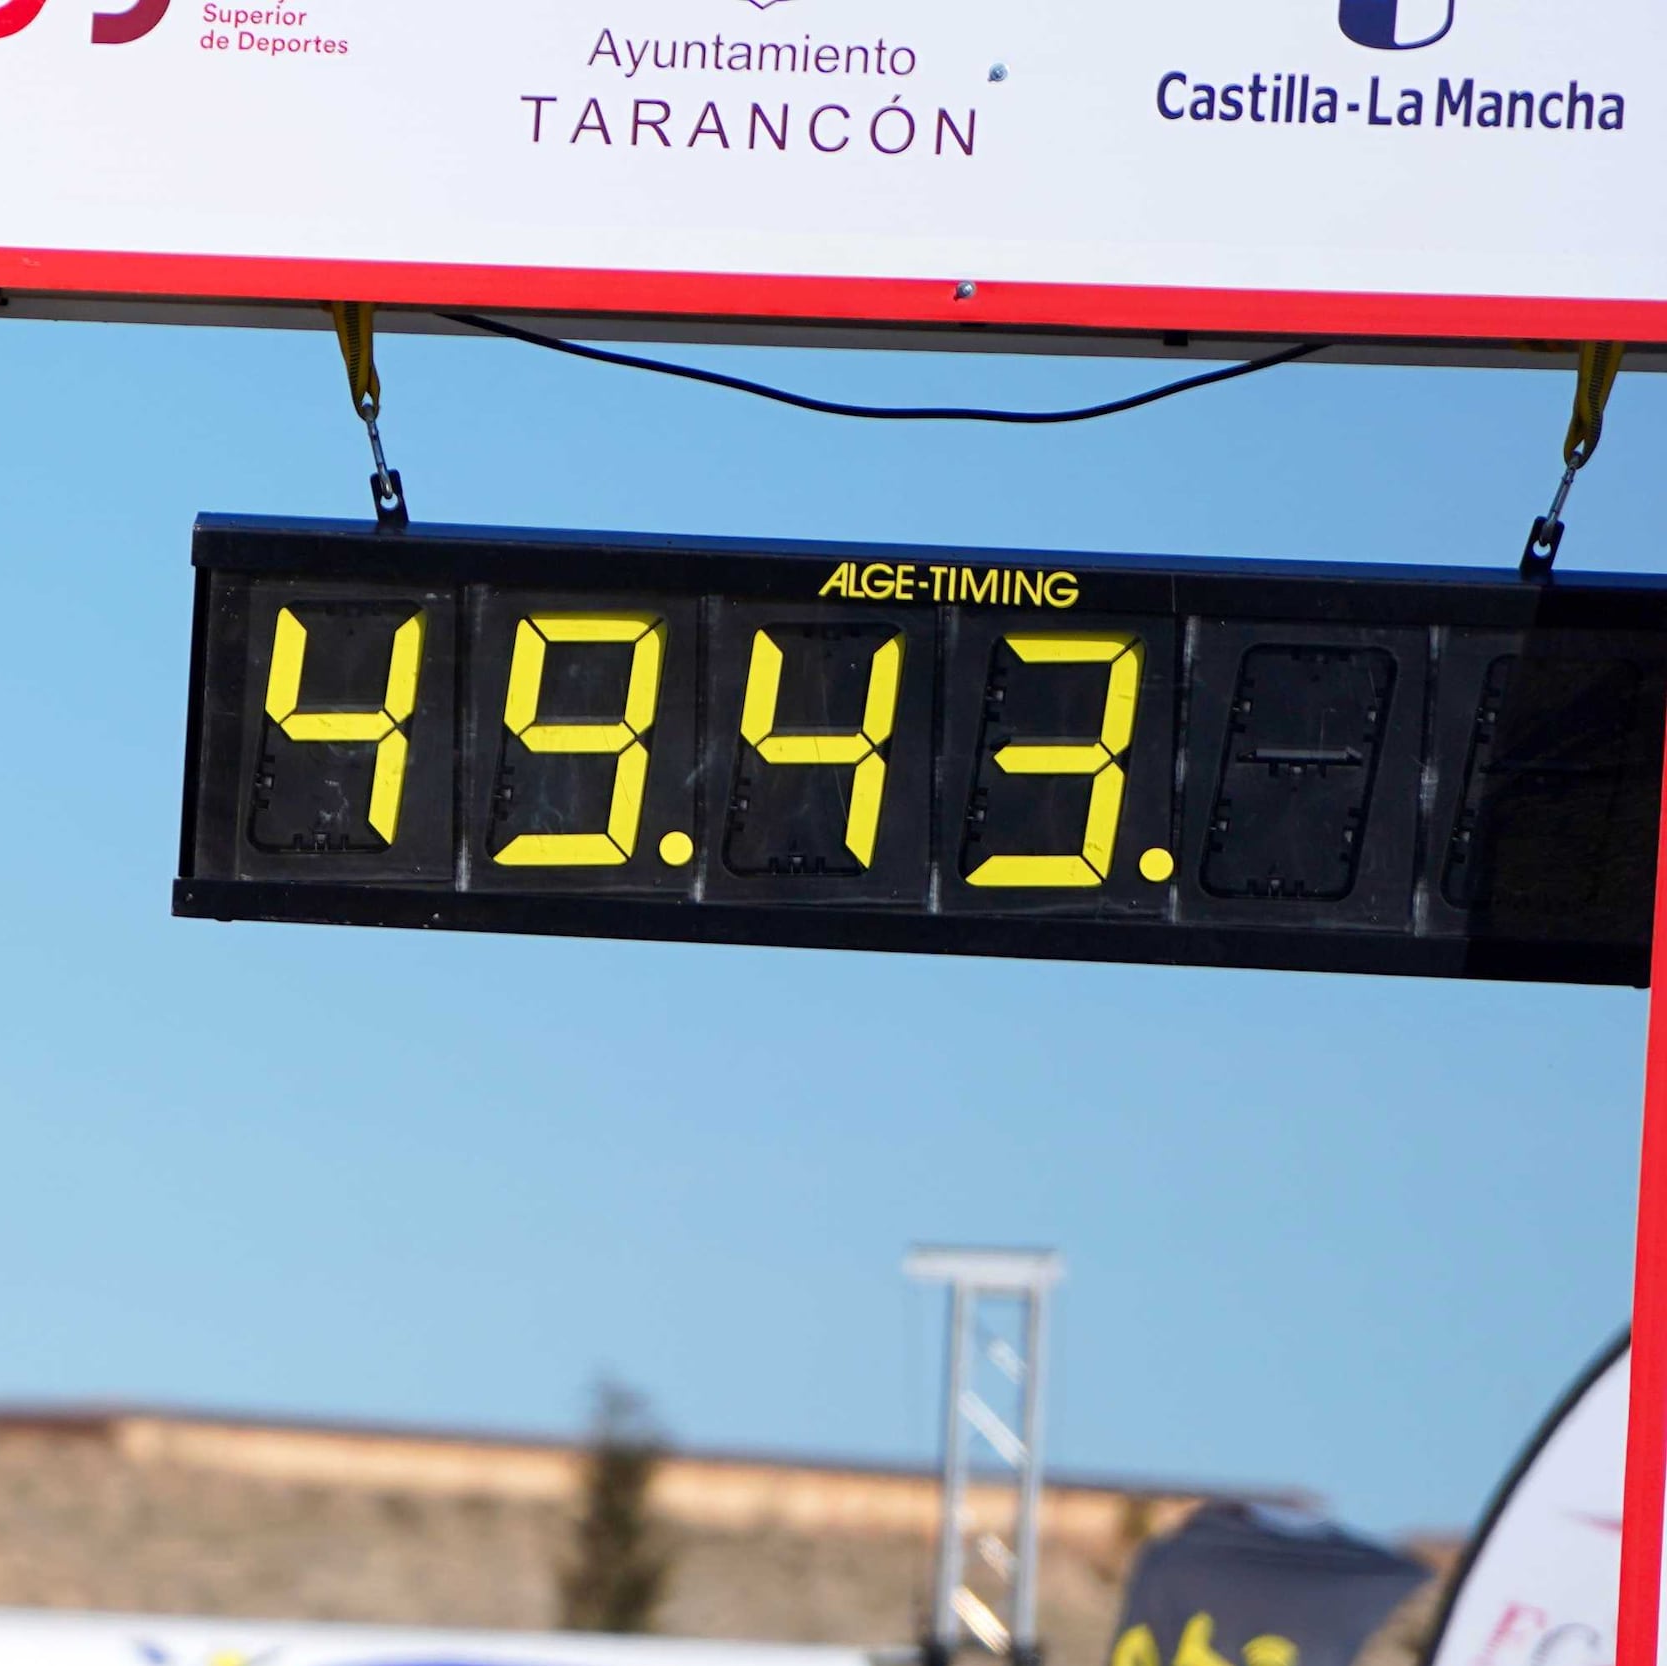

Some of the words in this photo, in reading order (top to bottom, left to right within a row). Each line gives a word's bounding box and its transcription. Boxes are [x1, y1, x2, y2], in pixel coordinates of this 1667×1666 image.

[202, 2, 307, 28] Superior
[200, 31, 229, 51] de
[237, 32, 349, 56] Deportes
[587, 27, 918, 78] Ayuntamiento
[520, 94, 978, 157] TARANCÓN
[1434, 77, 1626, 131] Mancha
[818, 561, 1080, 609] ALGE-TIMING
